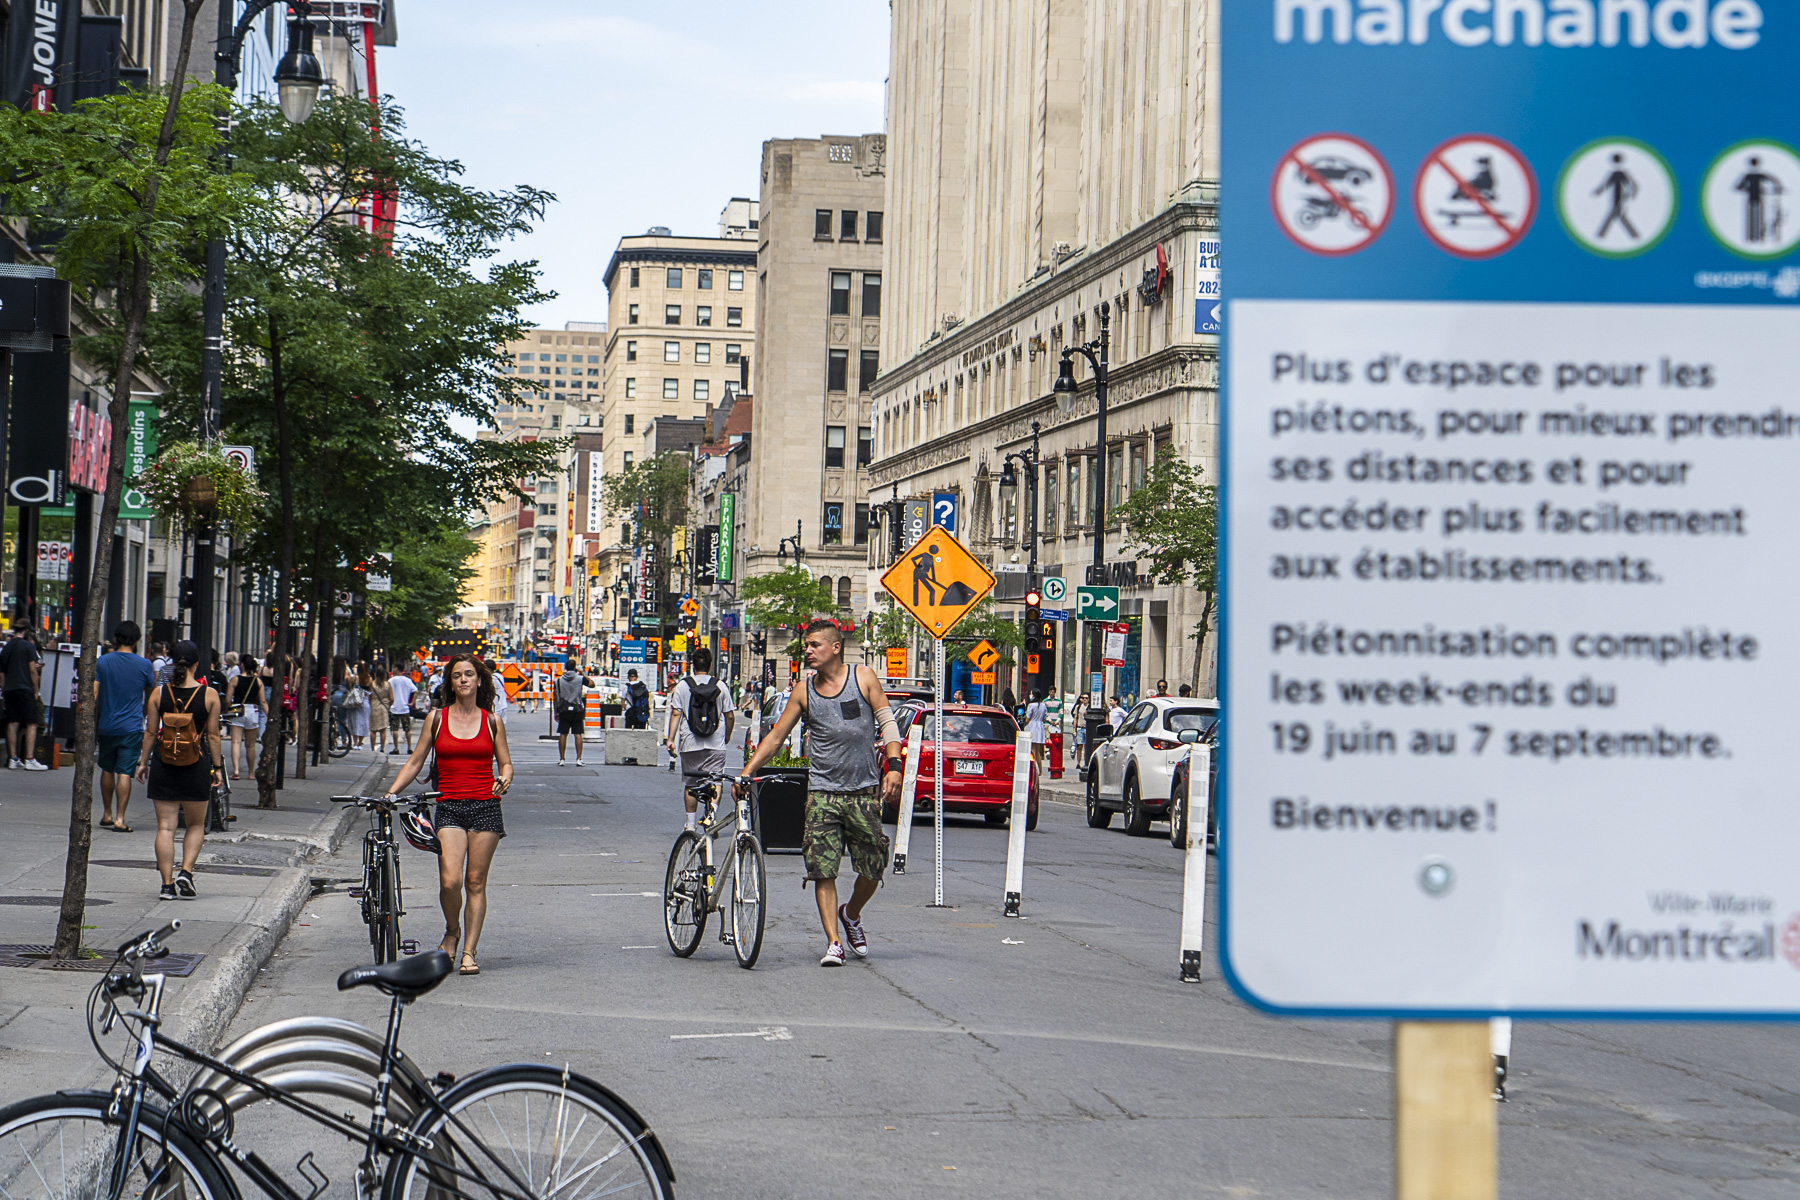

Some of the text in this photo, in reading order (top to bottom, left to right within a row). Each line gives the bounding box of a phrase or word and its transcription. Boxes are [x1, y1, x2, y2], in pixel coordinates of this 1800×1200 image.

[1273, 353, 1716, 392] Plus d'espace pour les
[1272, 405, 1425, 437] piétons,
[1438, 411, 1527, 440] pour
[1540, 411, 1655, 436] mieux
[1272, 453, 1691, 489] ses distances et pour
[1271, 502, 1744, 536] accéder plus facilement
[565, 508, 574, 587] GYM
[706, 532, 719, 576] Moores
[721, 507, 730, 579] PHARMACIE
[1270, 550, 1662, 583] aux établissements.
[1272, 624, 1757, 662] Piétonnisation complète
[1271, 673, 1615, 707] les week-ends du
[1271, 722, 1730, 762] 19 juin au 7 septembre.
[1579, 921, 1774, 959] Montréal
